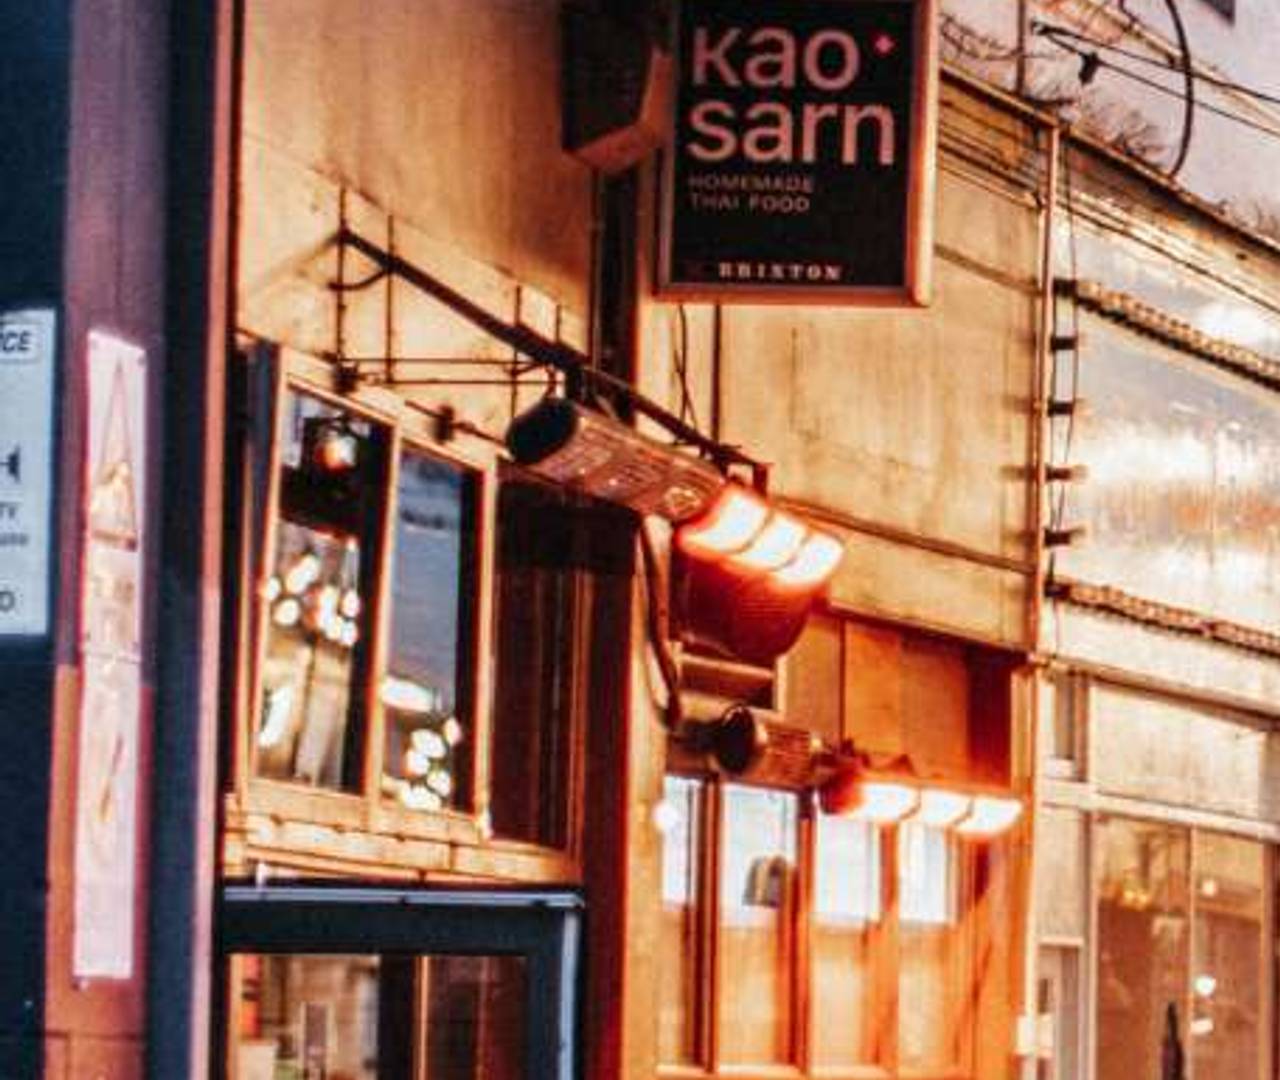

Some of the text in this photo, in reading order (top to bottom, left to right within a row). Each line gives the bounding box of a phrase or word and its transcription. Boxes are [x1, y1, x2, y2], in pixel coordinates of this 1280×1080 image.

[686, 101, 896, 166] sarn
[688, 172, 813, 194] HOMEMADE
[690, 194, 811, 213] THAI FOOD
[719, 262, 842, 281] BRIXTON
